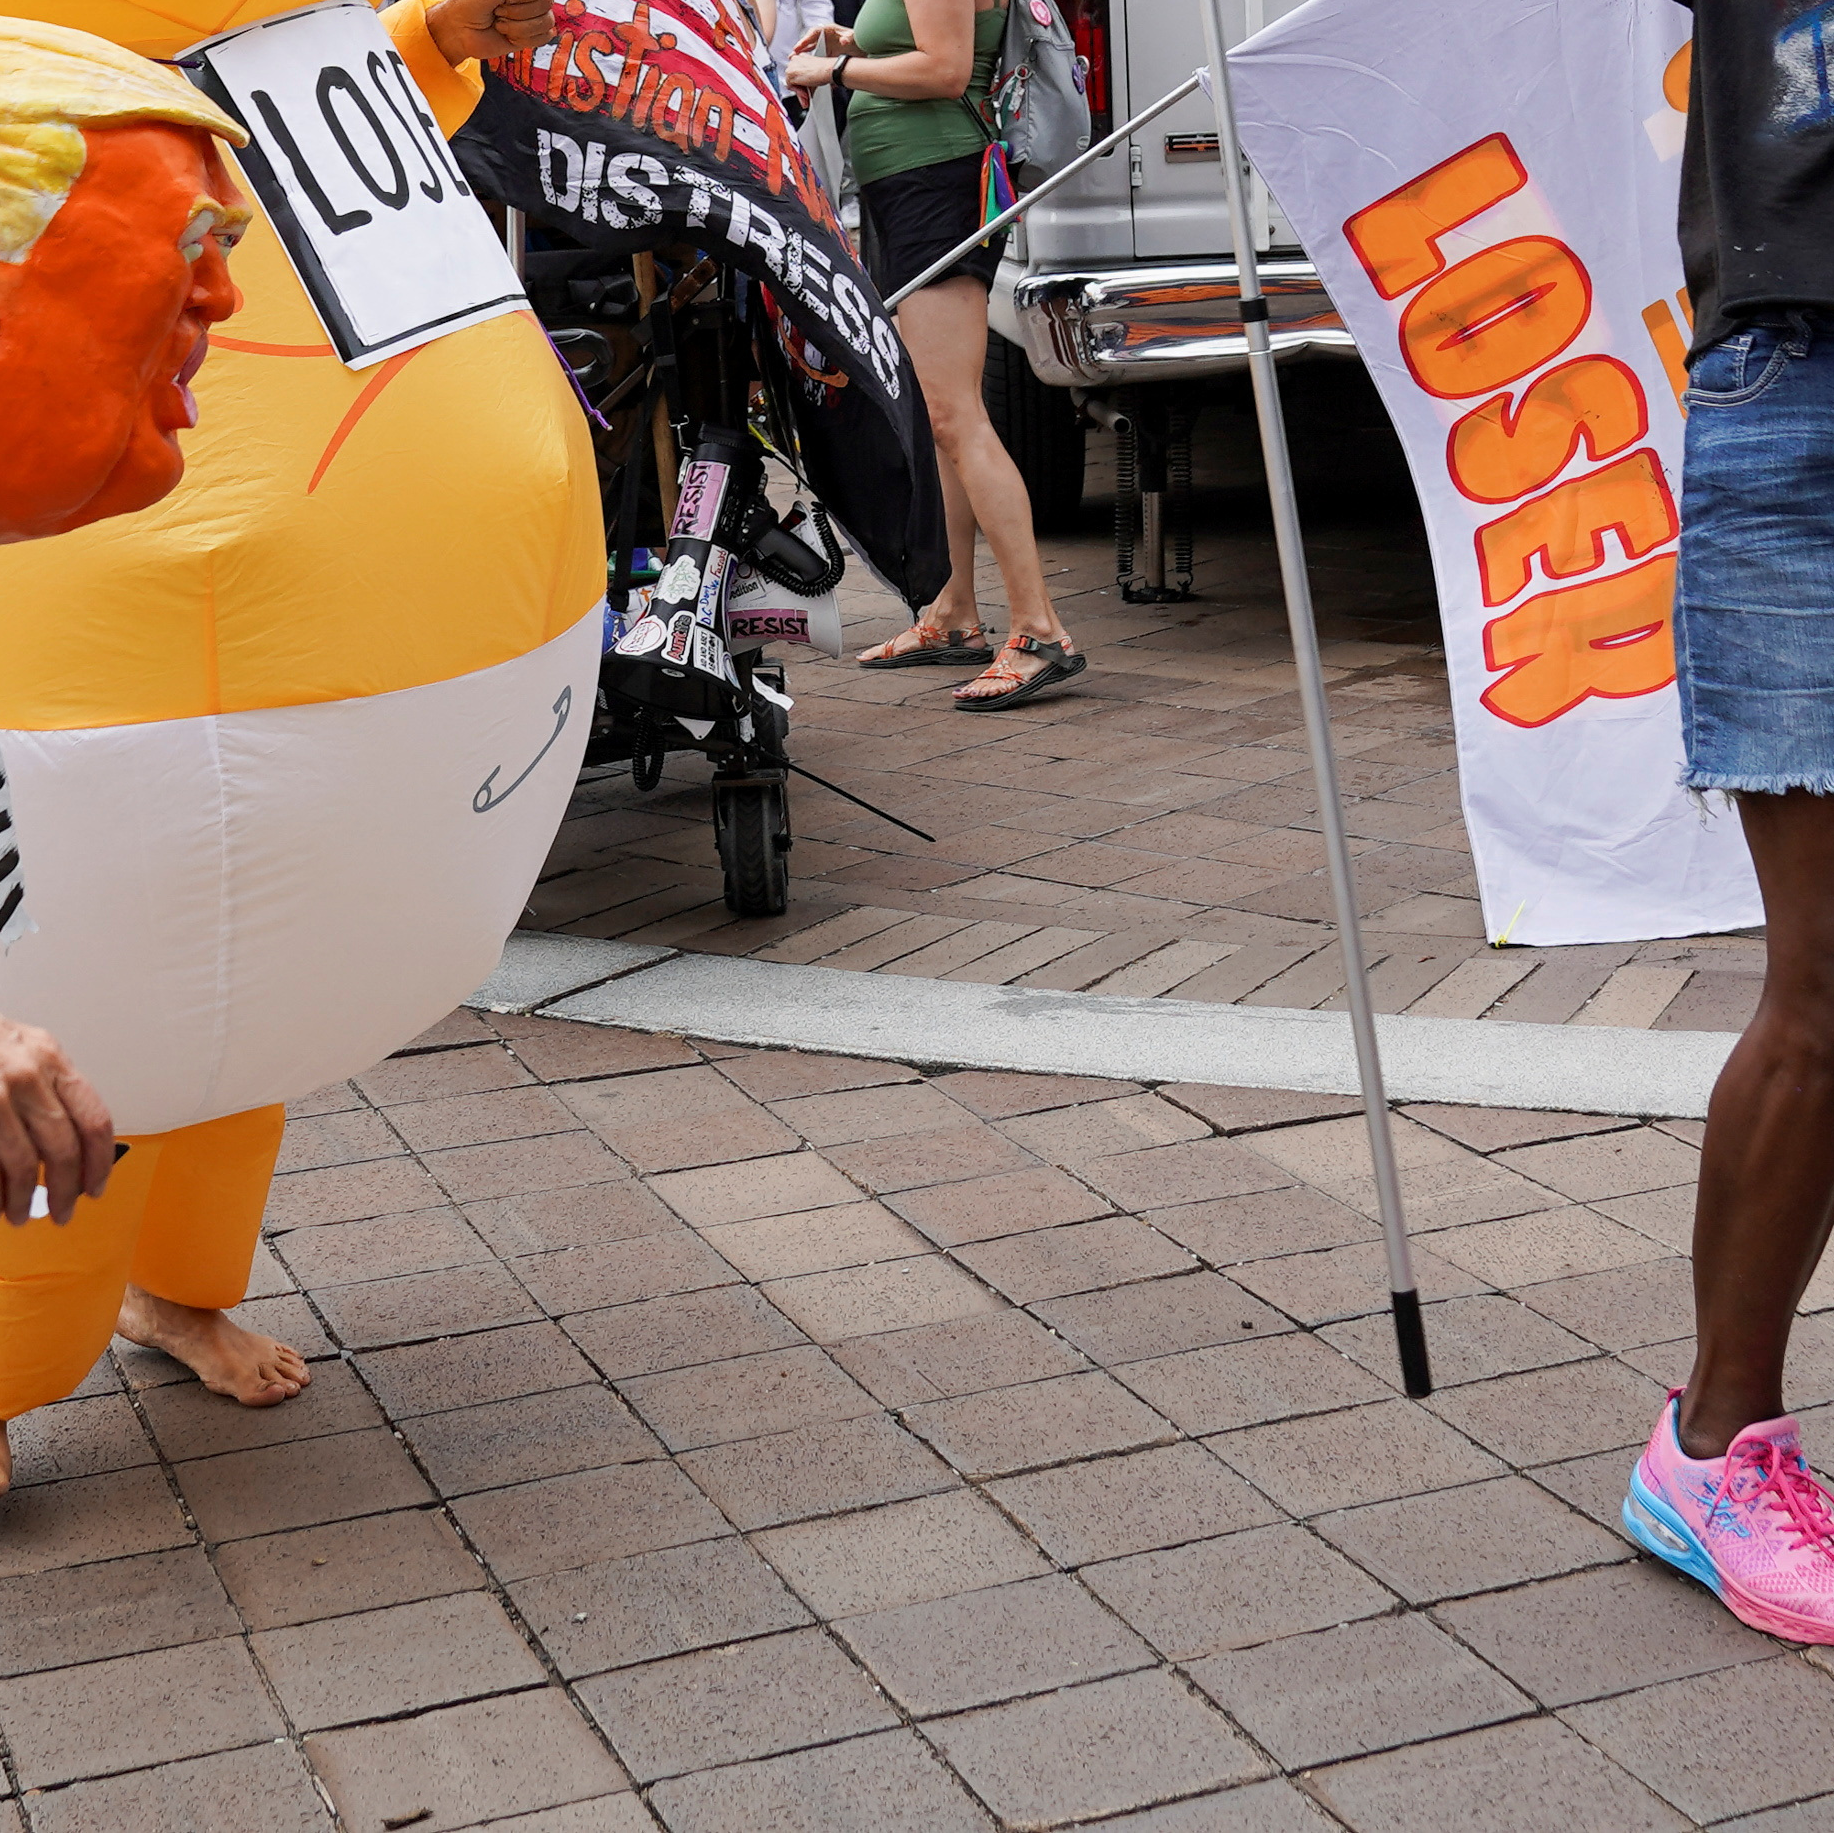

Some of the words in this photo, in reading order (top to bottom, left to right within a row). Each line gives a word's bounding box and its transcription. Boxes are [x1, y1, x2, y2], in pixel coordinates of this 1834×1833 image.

[536, 128, 901, 401] DISTRESS
[674, 462, 712, 536] RESIST
[1340, 129, 1680, 729] LOSER
[730, 616, 809, 638] RESIST
